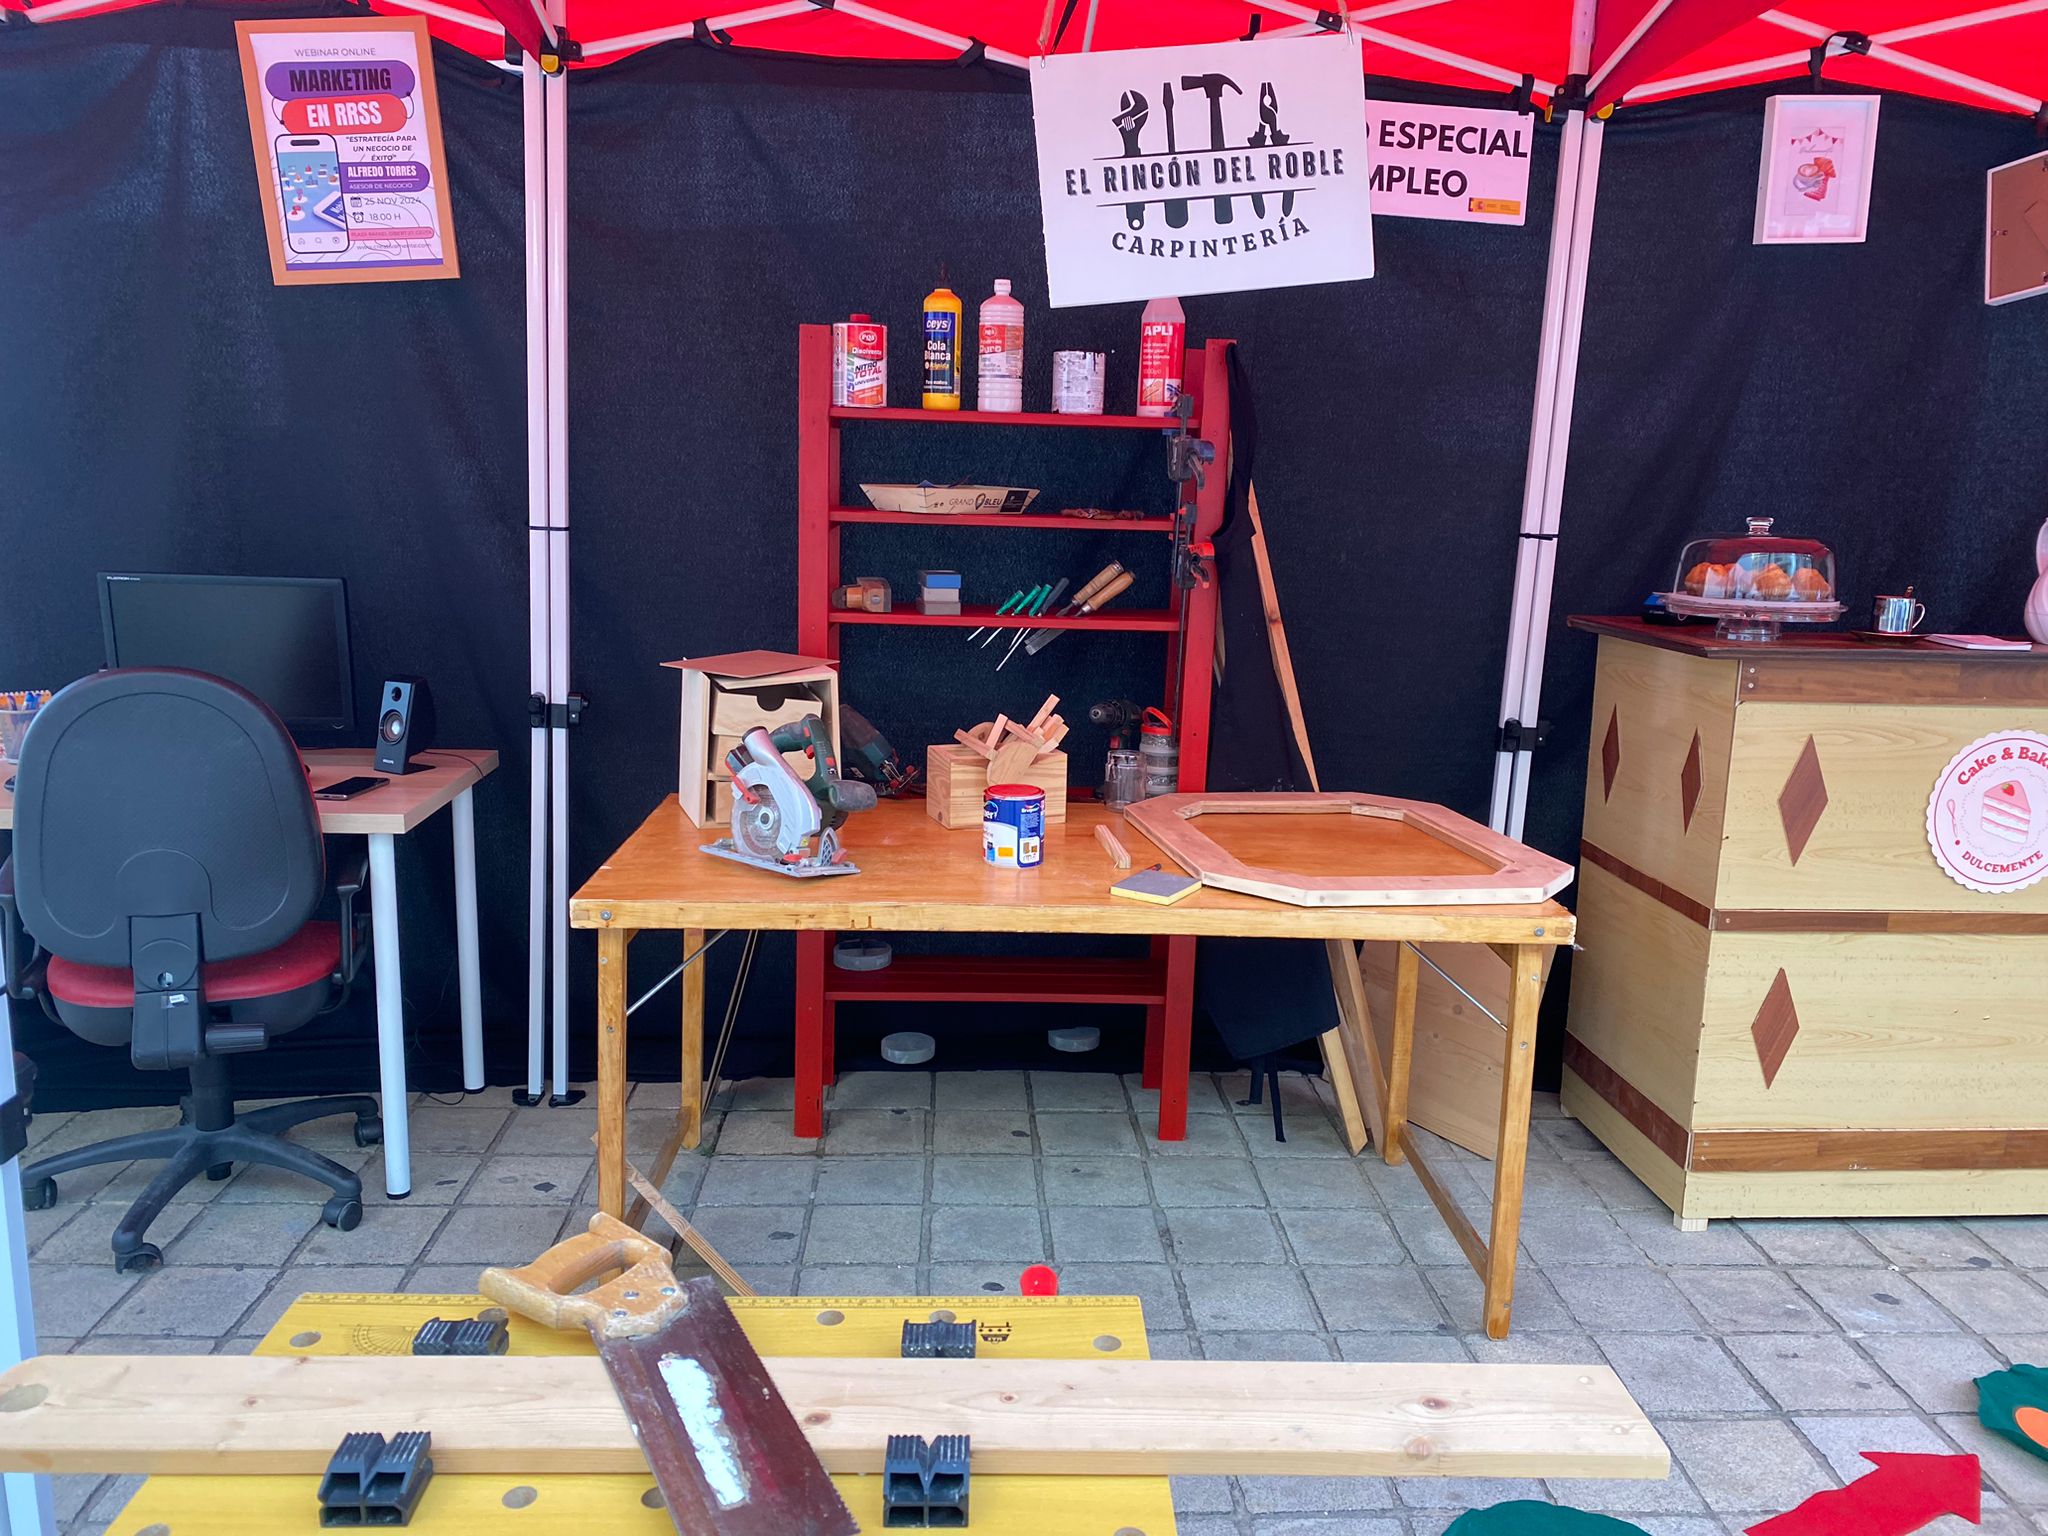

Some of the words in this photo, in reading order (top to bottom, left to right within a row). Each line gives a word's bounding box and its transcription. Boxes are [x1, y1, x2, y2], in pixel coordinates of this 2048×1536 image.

[294, 48, 339, 57] WEBINAR
[341, 47, 376, 56] ONLINE
[288, 68, 392, 92] MARKETING
[306, 103, 330, 128] EN
[334, 101, 383, 126] RRSS
[1379, 119, 1528, 158] ESPECIAL
[347, 166, 383, 177] ALFREDO
[385, 165, 416, 176] TORRES
[1065, 168, 1092, 195] EL
[1103, 156, 1201, 193] RINCÓN
[1213, 155, 1256, 184] DEL
[1268, 148, 1344, 180] ROBLE
[377, 197, 397, 205] NOV
[1111, 216, 1310, 258] CARPINTERÍA
[926, 319, 949, 330] ceys
[1144, 325, 1173, 336] APLI
[927, 340, 946, 351] Cola
[924, 350, 951, 361] Blanca
[854, 366, 882, 379] TOTAL
[855, 361, 878, 372] NITRO
[949, 498, 974, 506] GRAND
[984, 498, 1003, 506] BLEU
[1958, 754, 1997, 785] Cake
[2001, 747, 2014, 760] &
[2018, 746, 2048, 769] Bak
[1961, 850, 2044, 873] DULCEMENTE
